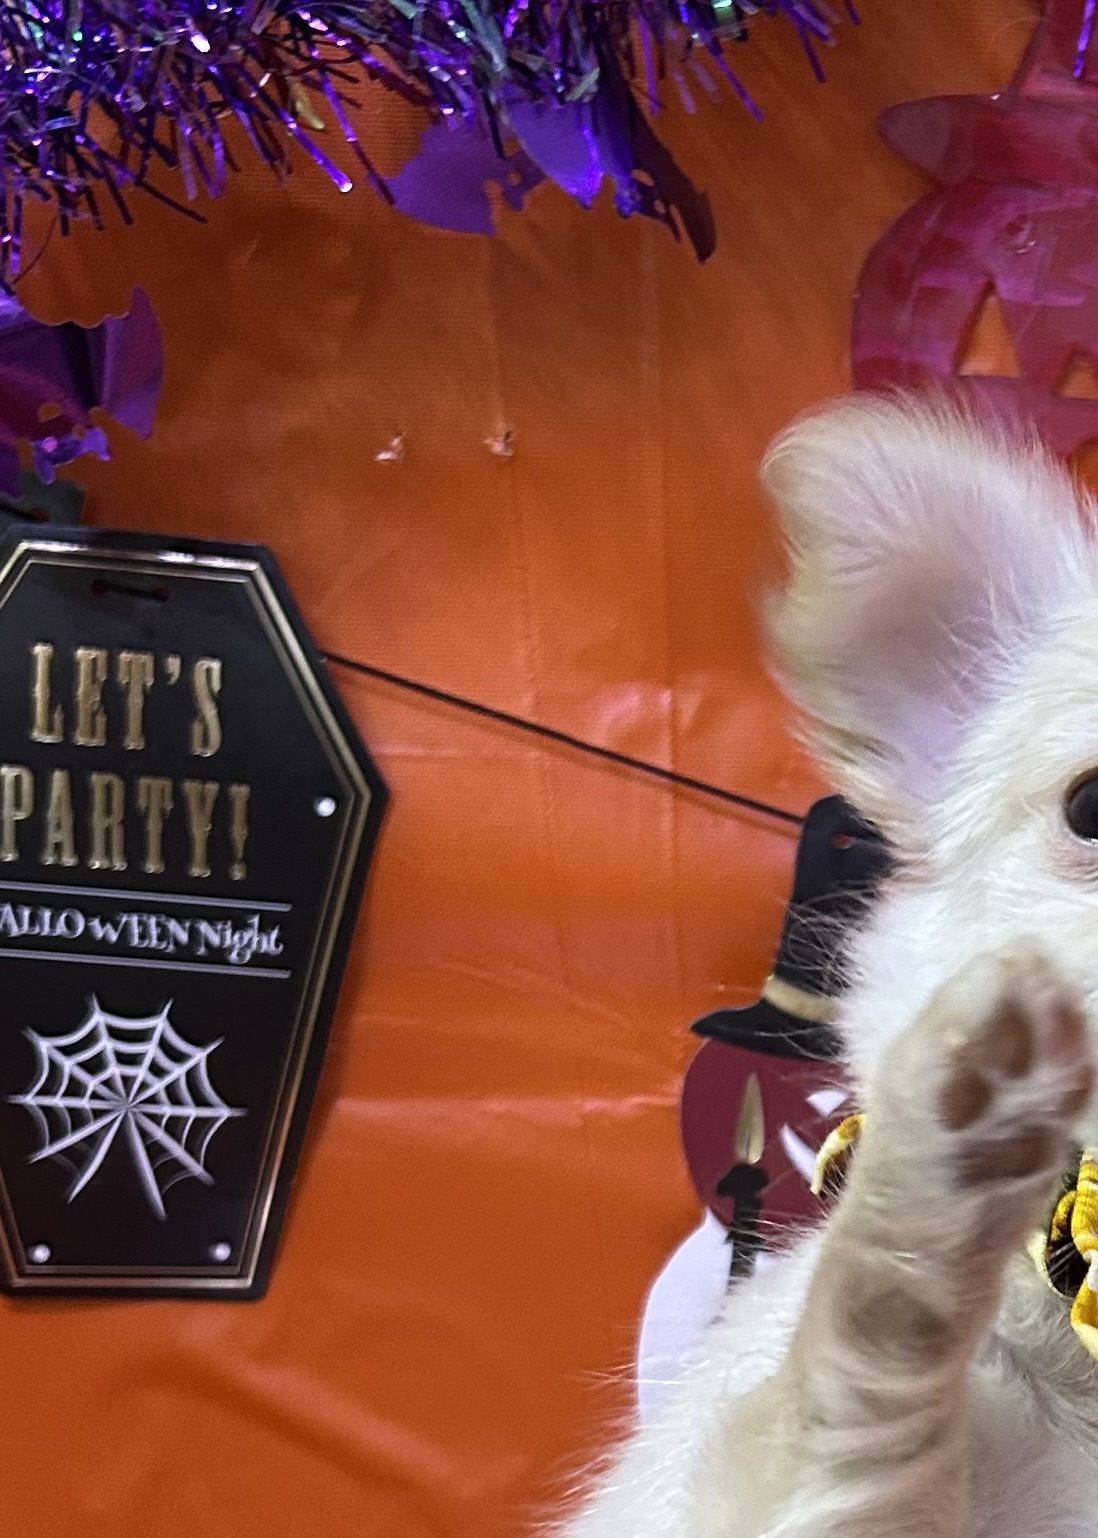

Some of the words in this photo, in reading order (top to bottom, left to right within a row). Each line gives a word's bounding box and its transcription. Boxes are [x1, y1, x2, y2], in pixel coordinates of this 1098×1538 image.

[30, 641, 224, 758] LET'S
[0, 763, 251, 881] PARTY!
[194, 912, 284, 965] Night
